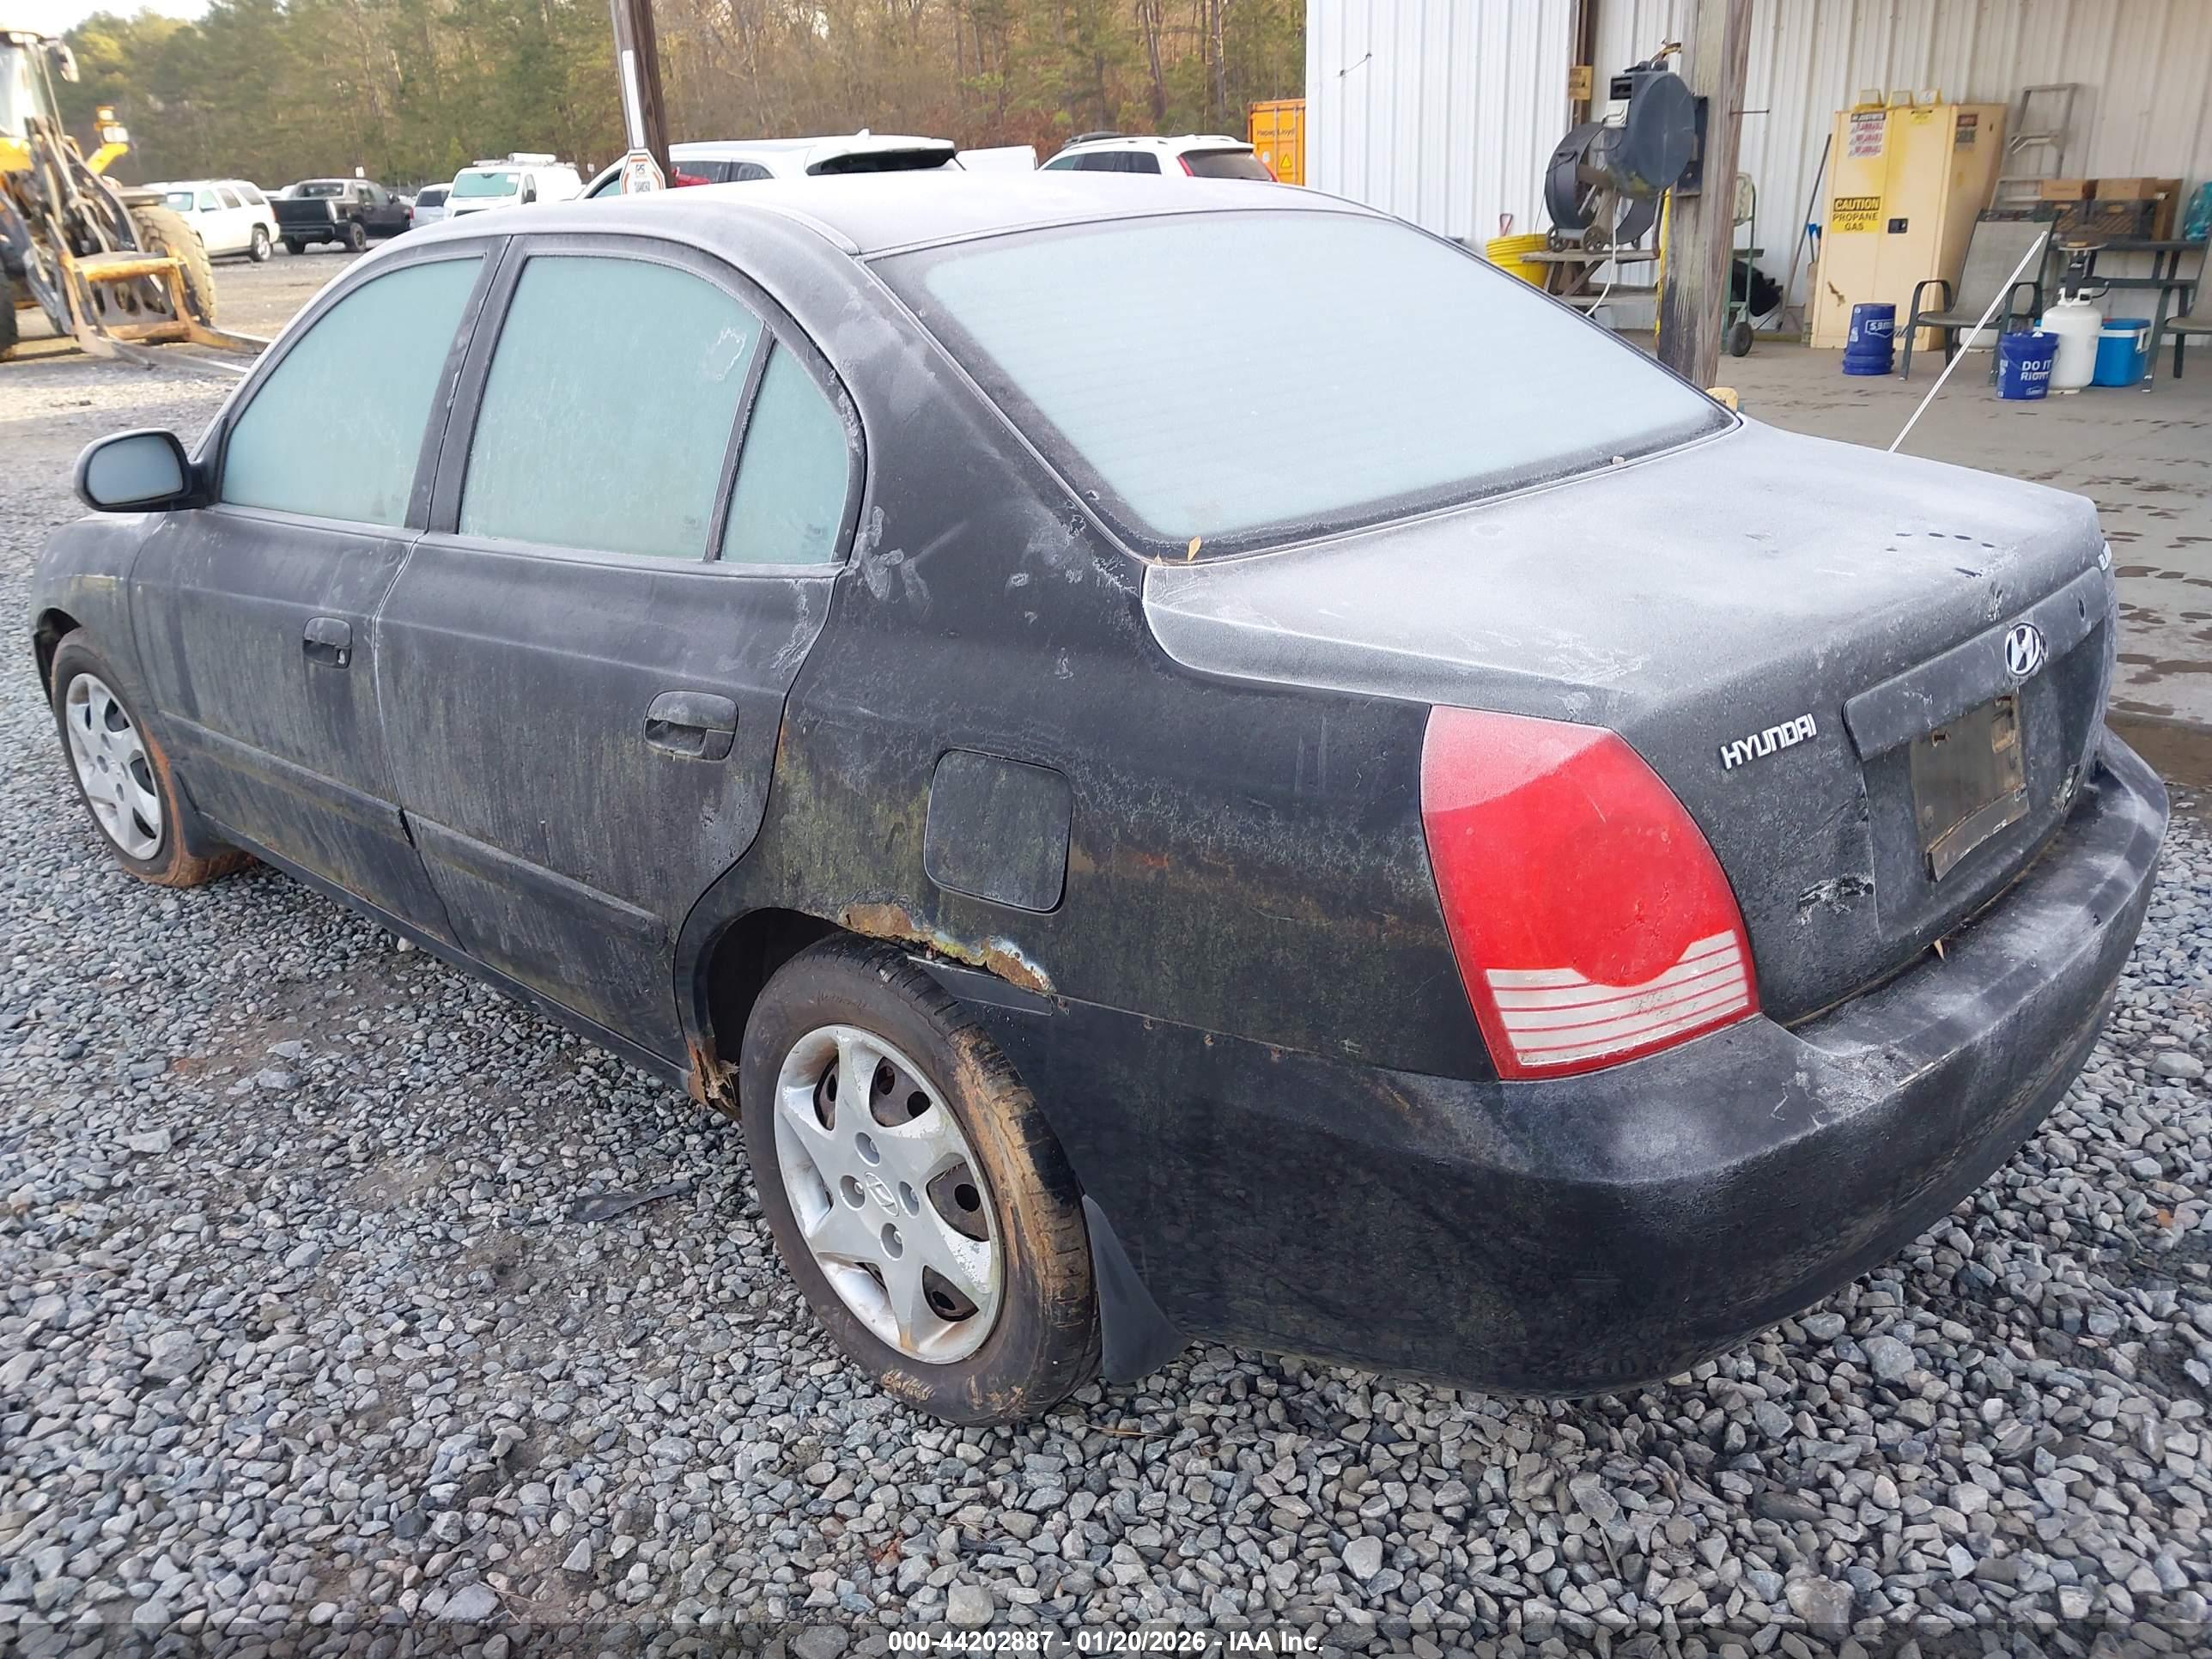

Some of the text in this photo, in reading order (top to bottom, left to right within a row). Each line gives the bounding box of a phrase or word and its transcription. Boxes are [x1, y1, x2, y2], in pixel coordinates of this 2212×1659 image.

[1835, 198, 1880, 210] CAUTION
[1832, 212, 1878, 222] PROPANE
[2021, 360, 2052, 371] DO IT
[1720, 713, 1817, 770] HYUNDAI
